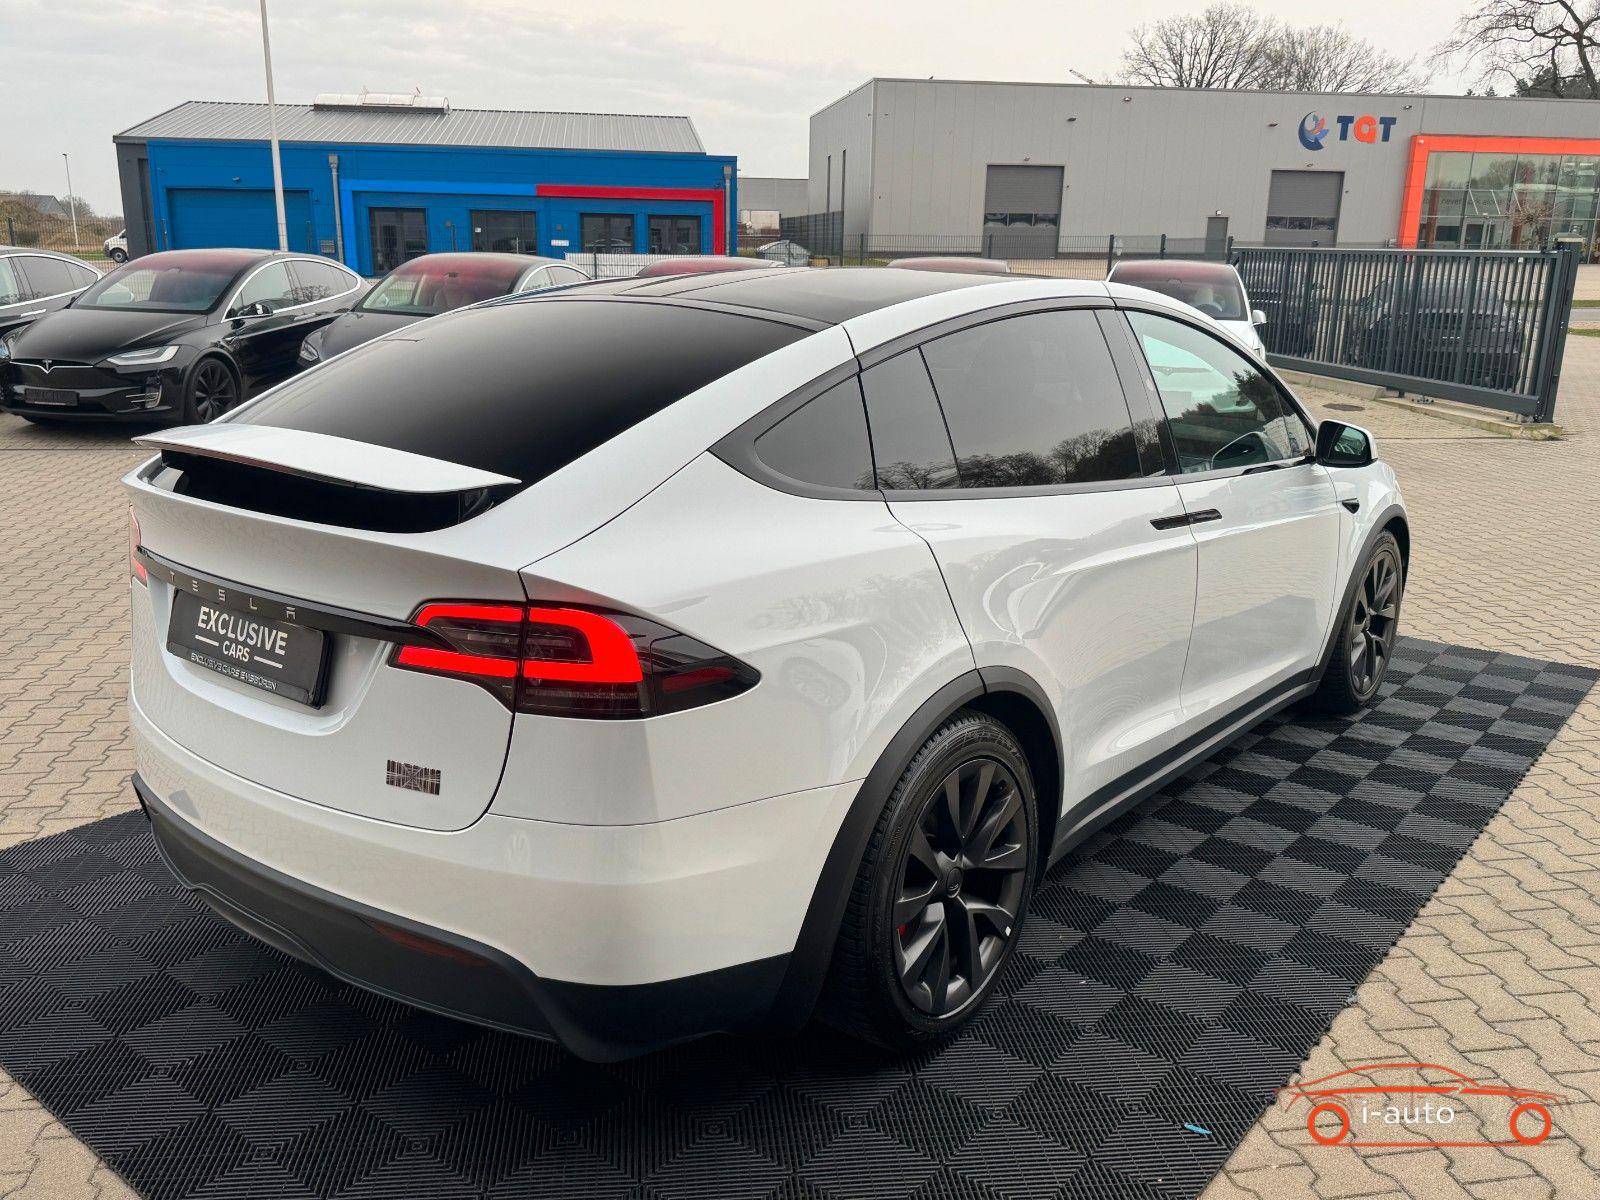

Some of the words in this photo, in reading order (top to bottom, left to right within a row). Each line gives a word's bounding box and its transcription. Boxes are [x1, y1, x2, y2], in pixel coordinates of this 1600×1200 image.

[169, 571, 296, 620] TESLA
[197, 606, 287, 655] EXCLUSIVE
[191, 652, 222, 671] EXCLUSIVE
[222, 664, 240, 677] CARS
[222, 640, 250, 662] CARS
